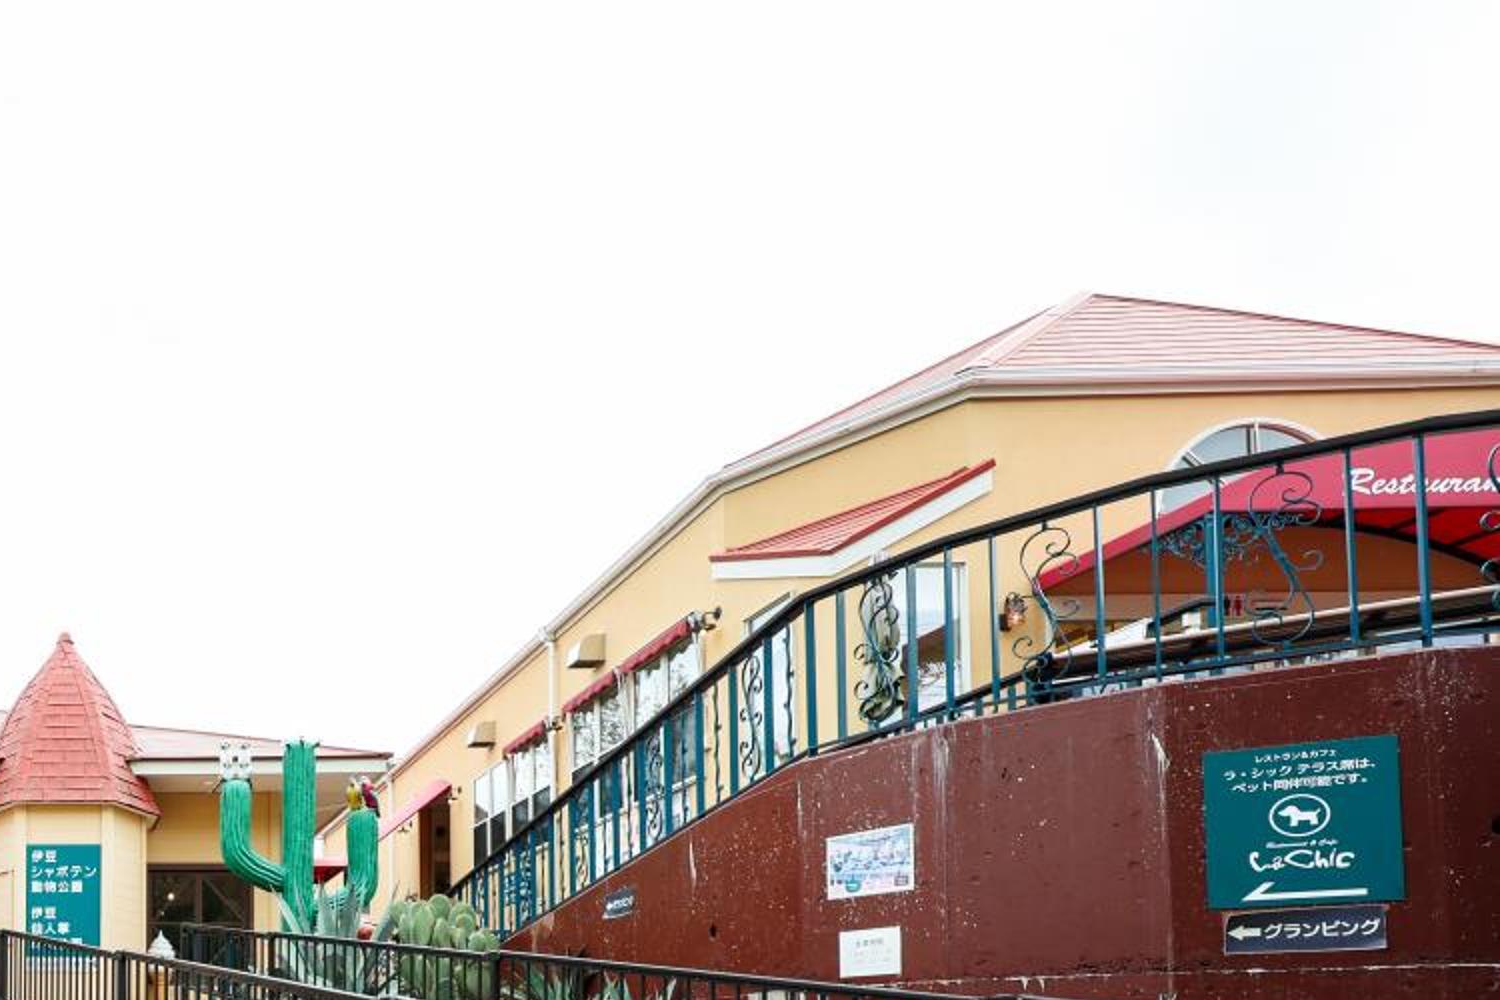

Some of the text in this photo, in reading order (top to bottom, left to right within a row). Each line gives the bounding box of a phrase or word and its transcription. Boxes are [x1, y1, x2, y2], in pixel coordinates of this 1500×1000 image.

[31, 849, 57, 863] 伊豆
[31, 865, 97, 878] シャボテン
[31, 880, 83, 893] 動物公園
[1264, 918, 1381, 940] グランピング
